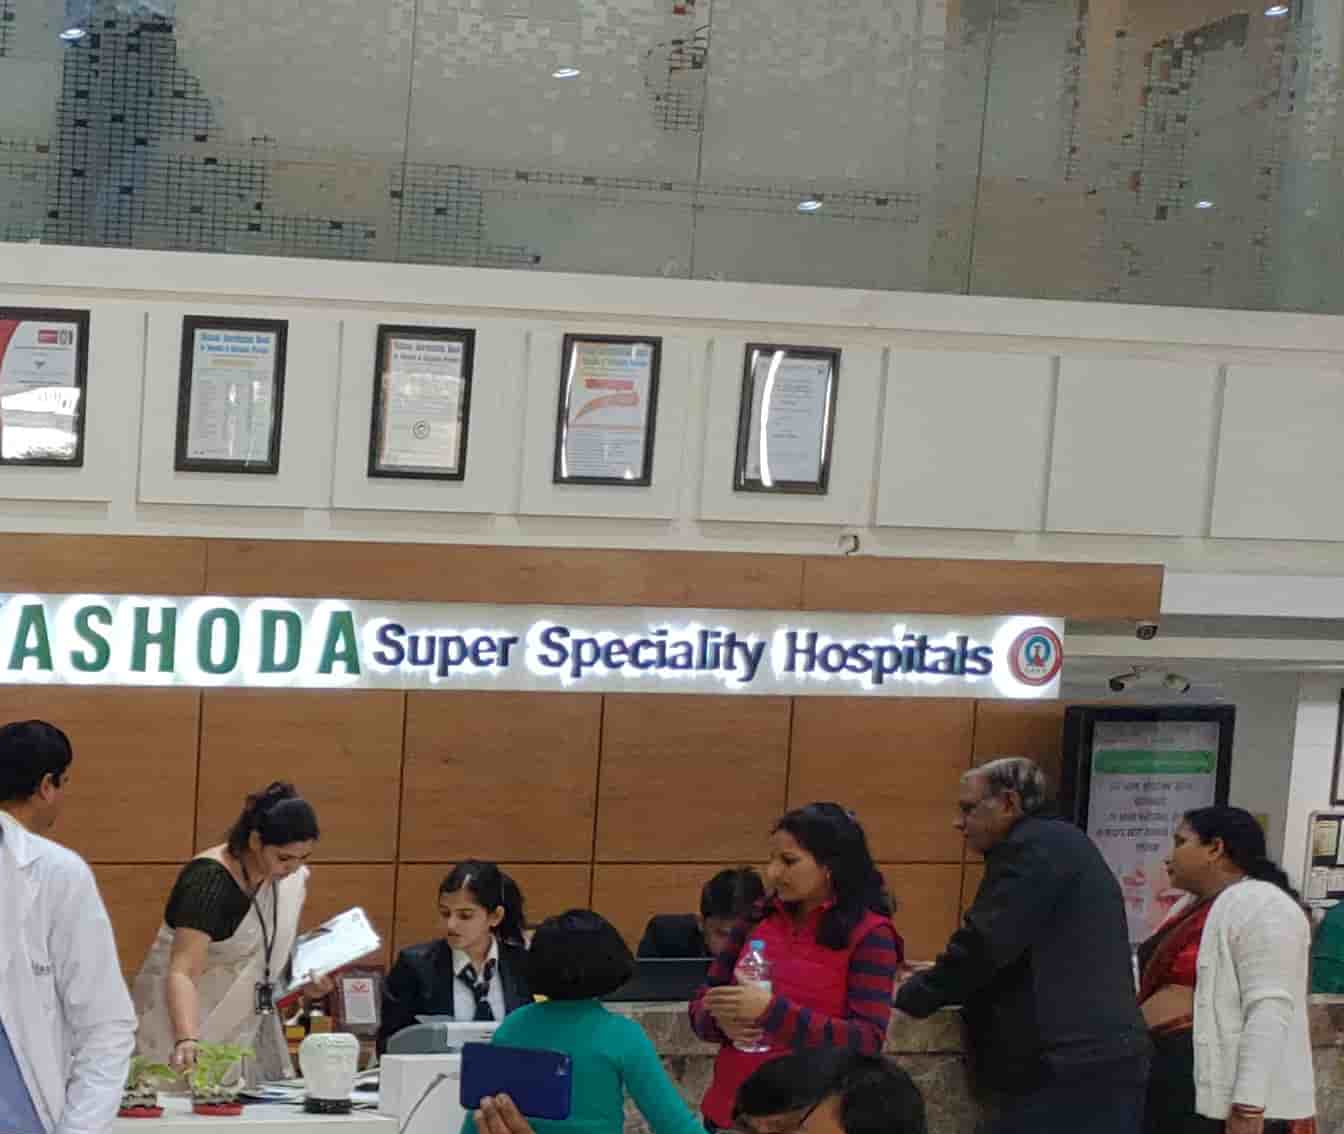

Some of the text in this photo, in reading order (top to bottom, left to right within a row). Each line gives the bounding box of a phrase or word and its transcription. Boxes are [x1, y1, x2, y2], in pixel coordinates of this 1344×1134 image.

[372, 623, 519, 677] Super
[536, 626, 766, 682] Speciality
[783, 631, 994, 685] Hospitals
